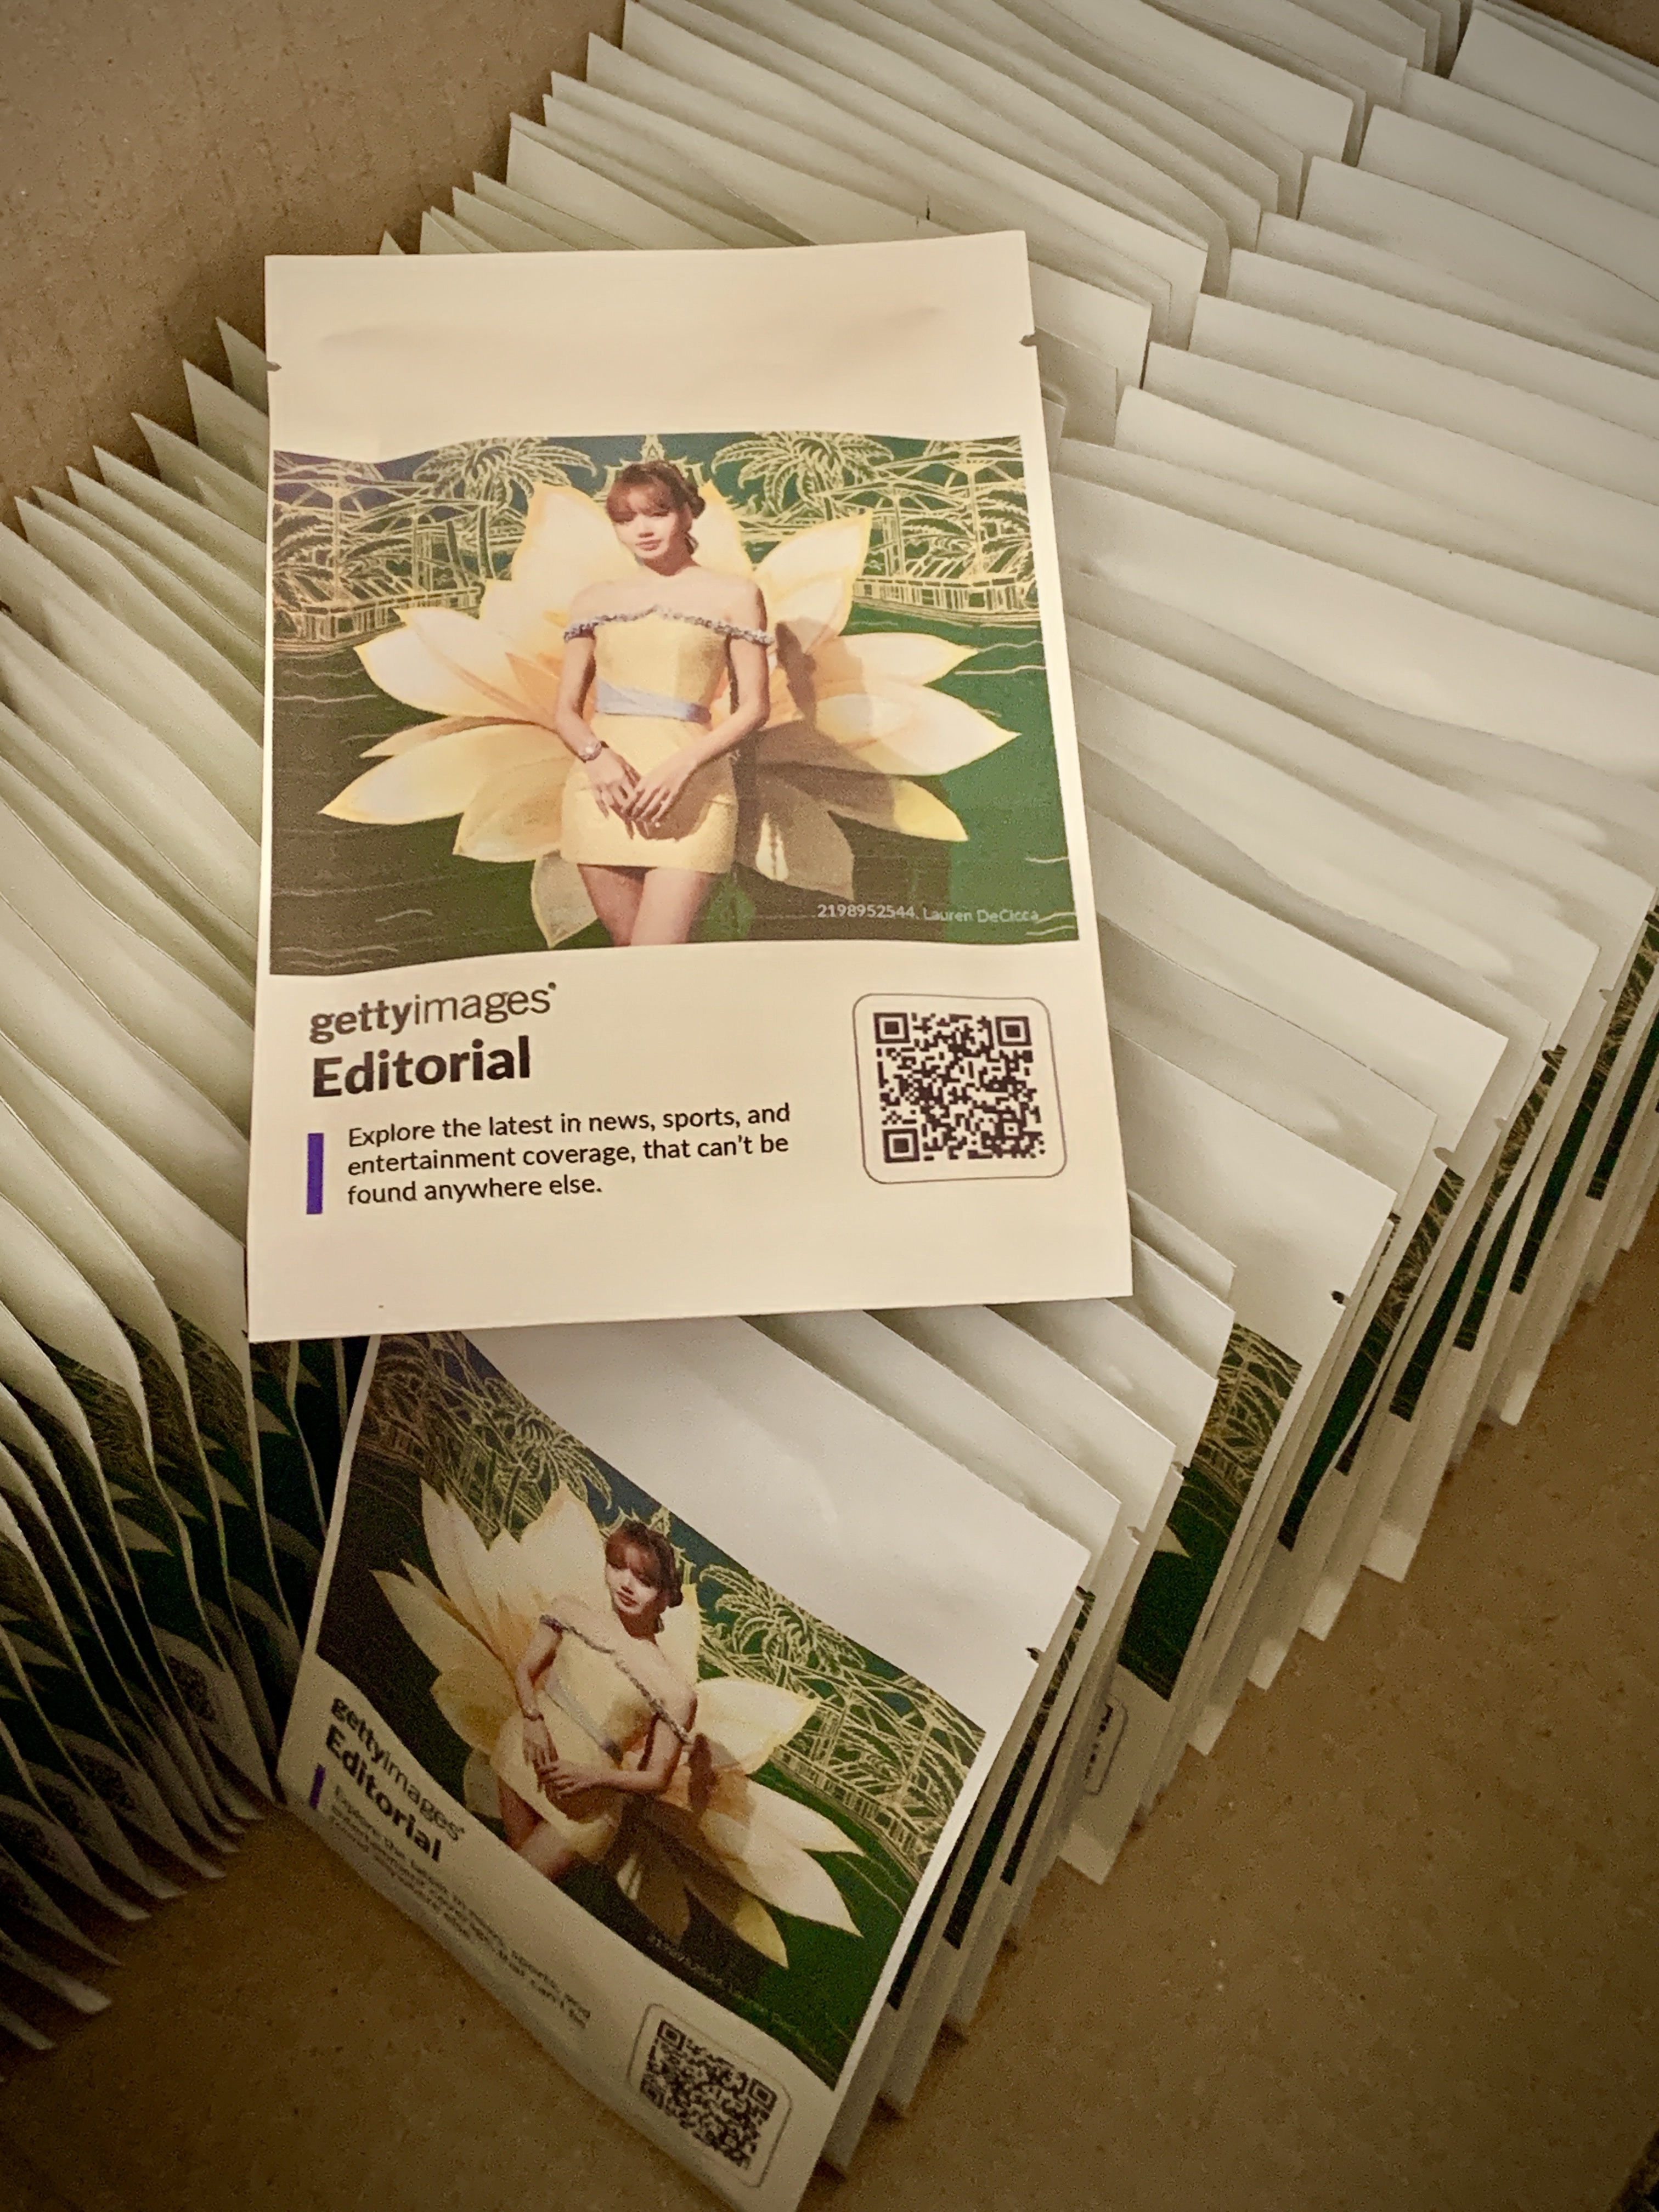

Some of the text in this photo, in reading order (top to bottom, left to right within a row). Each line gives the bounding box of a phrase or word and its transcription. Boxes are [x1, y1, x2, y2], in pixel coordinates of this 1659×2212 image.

[923, 907, 973, 922] Lauren
[977, 909, 1039, 923] DeCicca
[313, 1035, 530, 1098] Editorial
[349, 1102, 790, 1147] Explore the latest in news, sports, and
[348, 1135, 788, 1176] entertainment coverage, that can't be
[348, 1174, 602, 1205] found anywhere else.
[326, 1725, 441, 1862] Editorial
